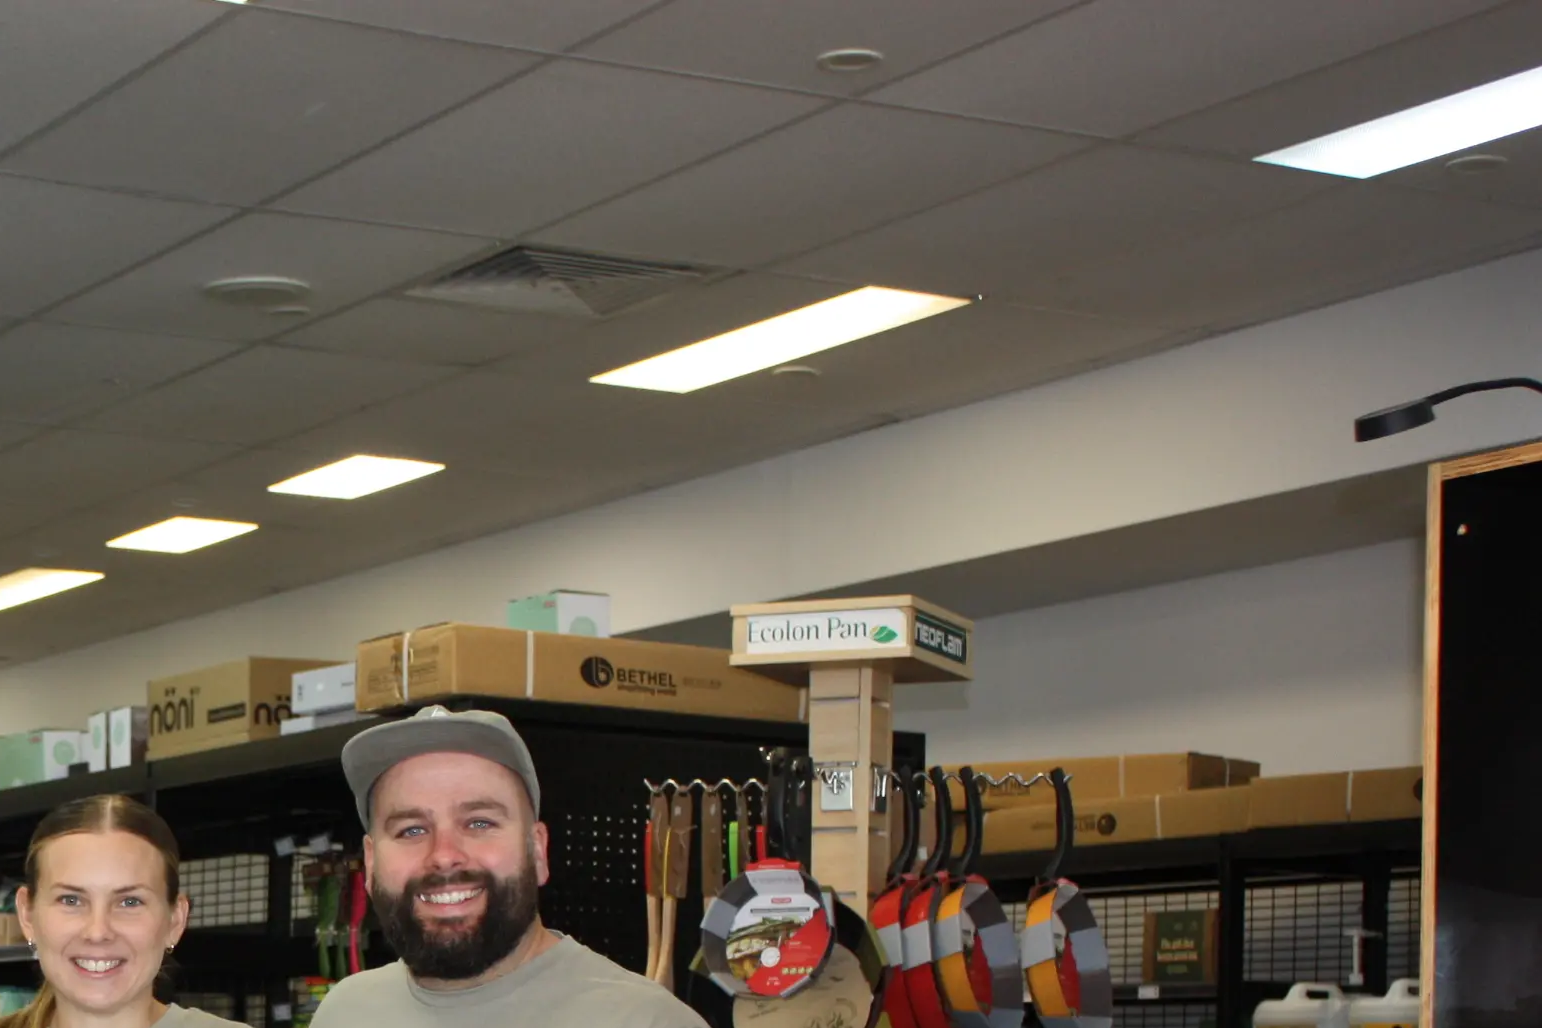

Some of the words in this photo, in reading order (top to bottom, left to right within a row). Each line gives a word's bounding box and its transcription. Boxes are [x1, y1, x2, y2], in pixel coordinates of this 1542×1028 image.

[748, 620, 819, 643] Ecolon
[828, 617, 867, 639] Pan
[616, 667, 677, 688] BETHEL
